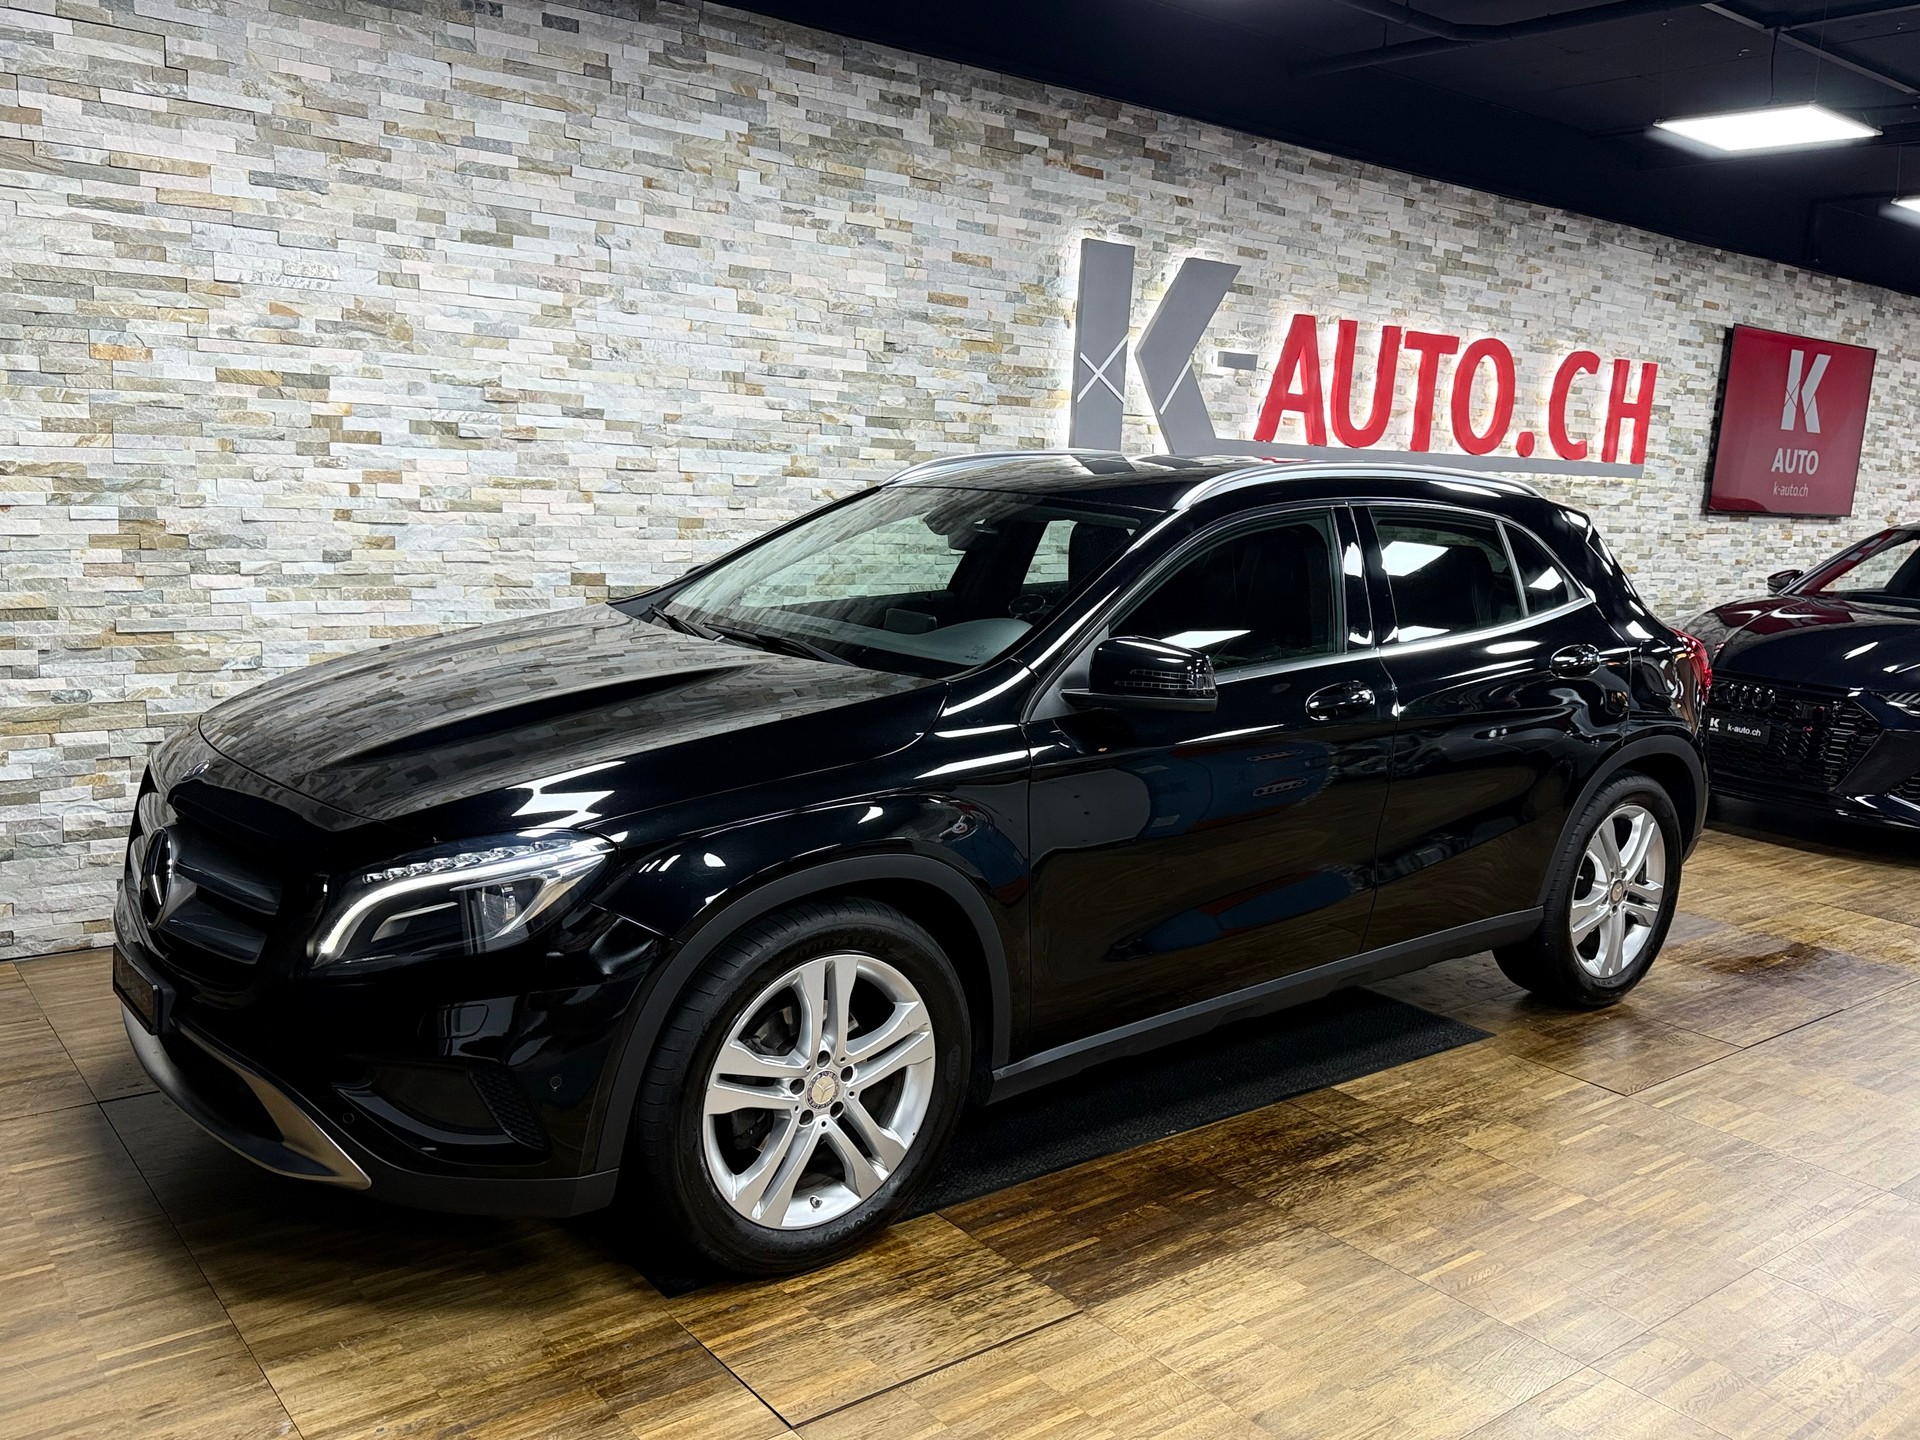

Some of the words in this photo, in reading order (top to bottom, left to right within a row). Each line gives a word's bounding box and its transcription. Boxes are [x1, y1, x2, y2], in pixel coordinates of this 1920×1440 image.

[1069, 238, 1657, 464] K-AUTO.CH
[1780, 348, 1832, 434] K
[1771, 447, 1820, 475] AUTO
[1773, 481, 1809, 497] k-auto.ch
[1709, 716, 1720, 728] K
[1727, 723, 1762, 737] k-auto.ch
